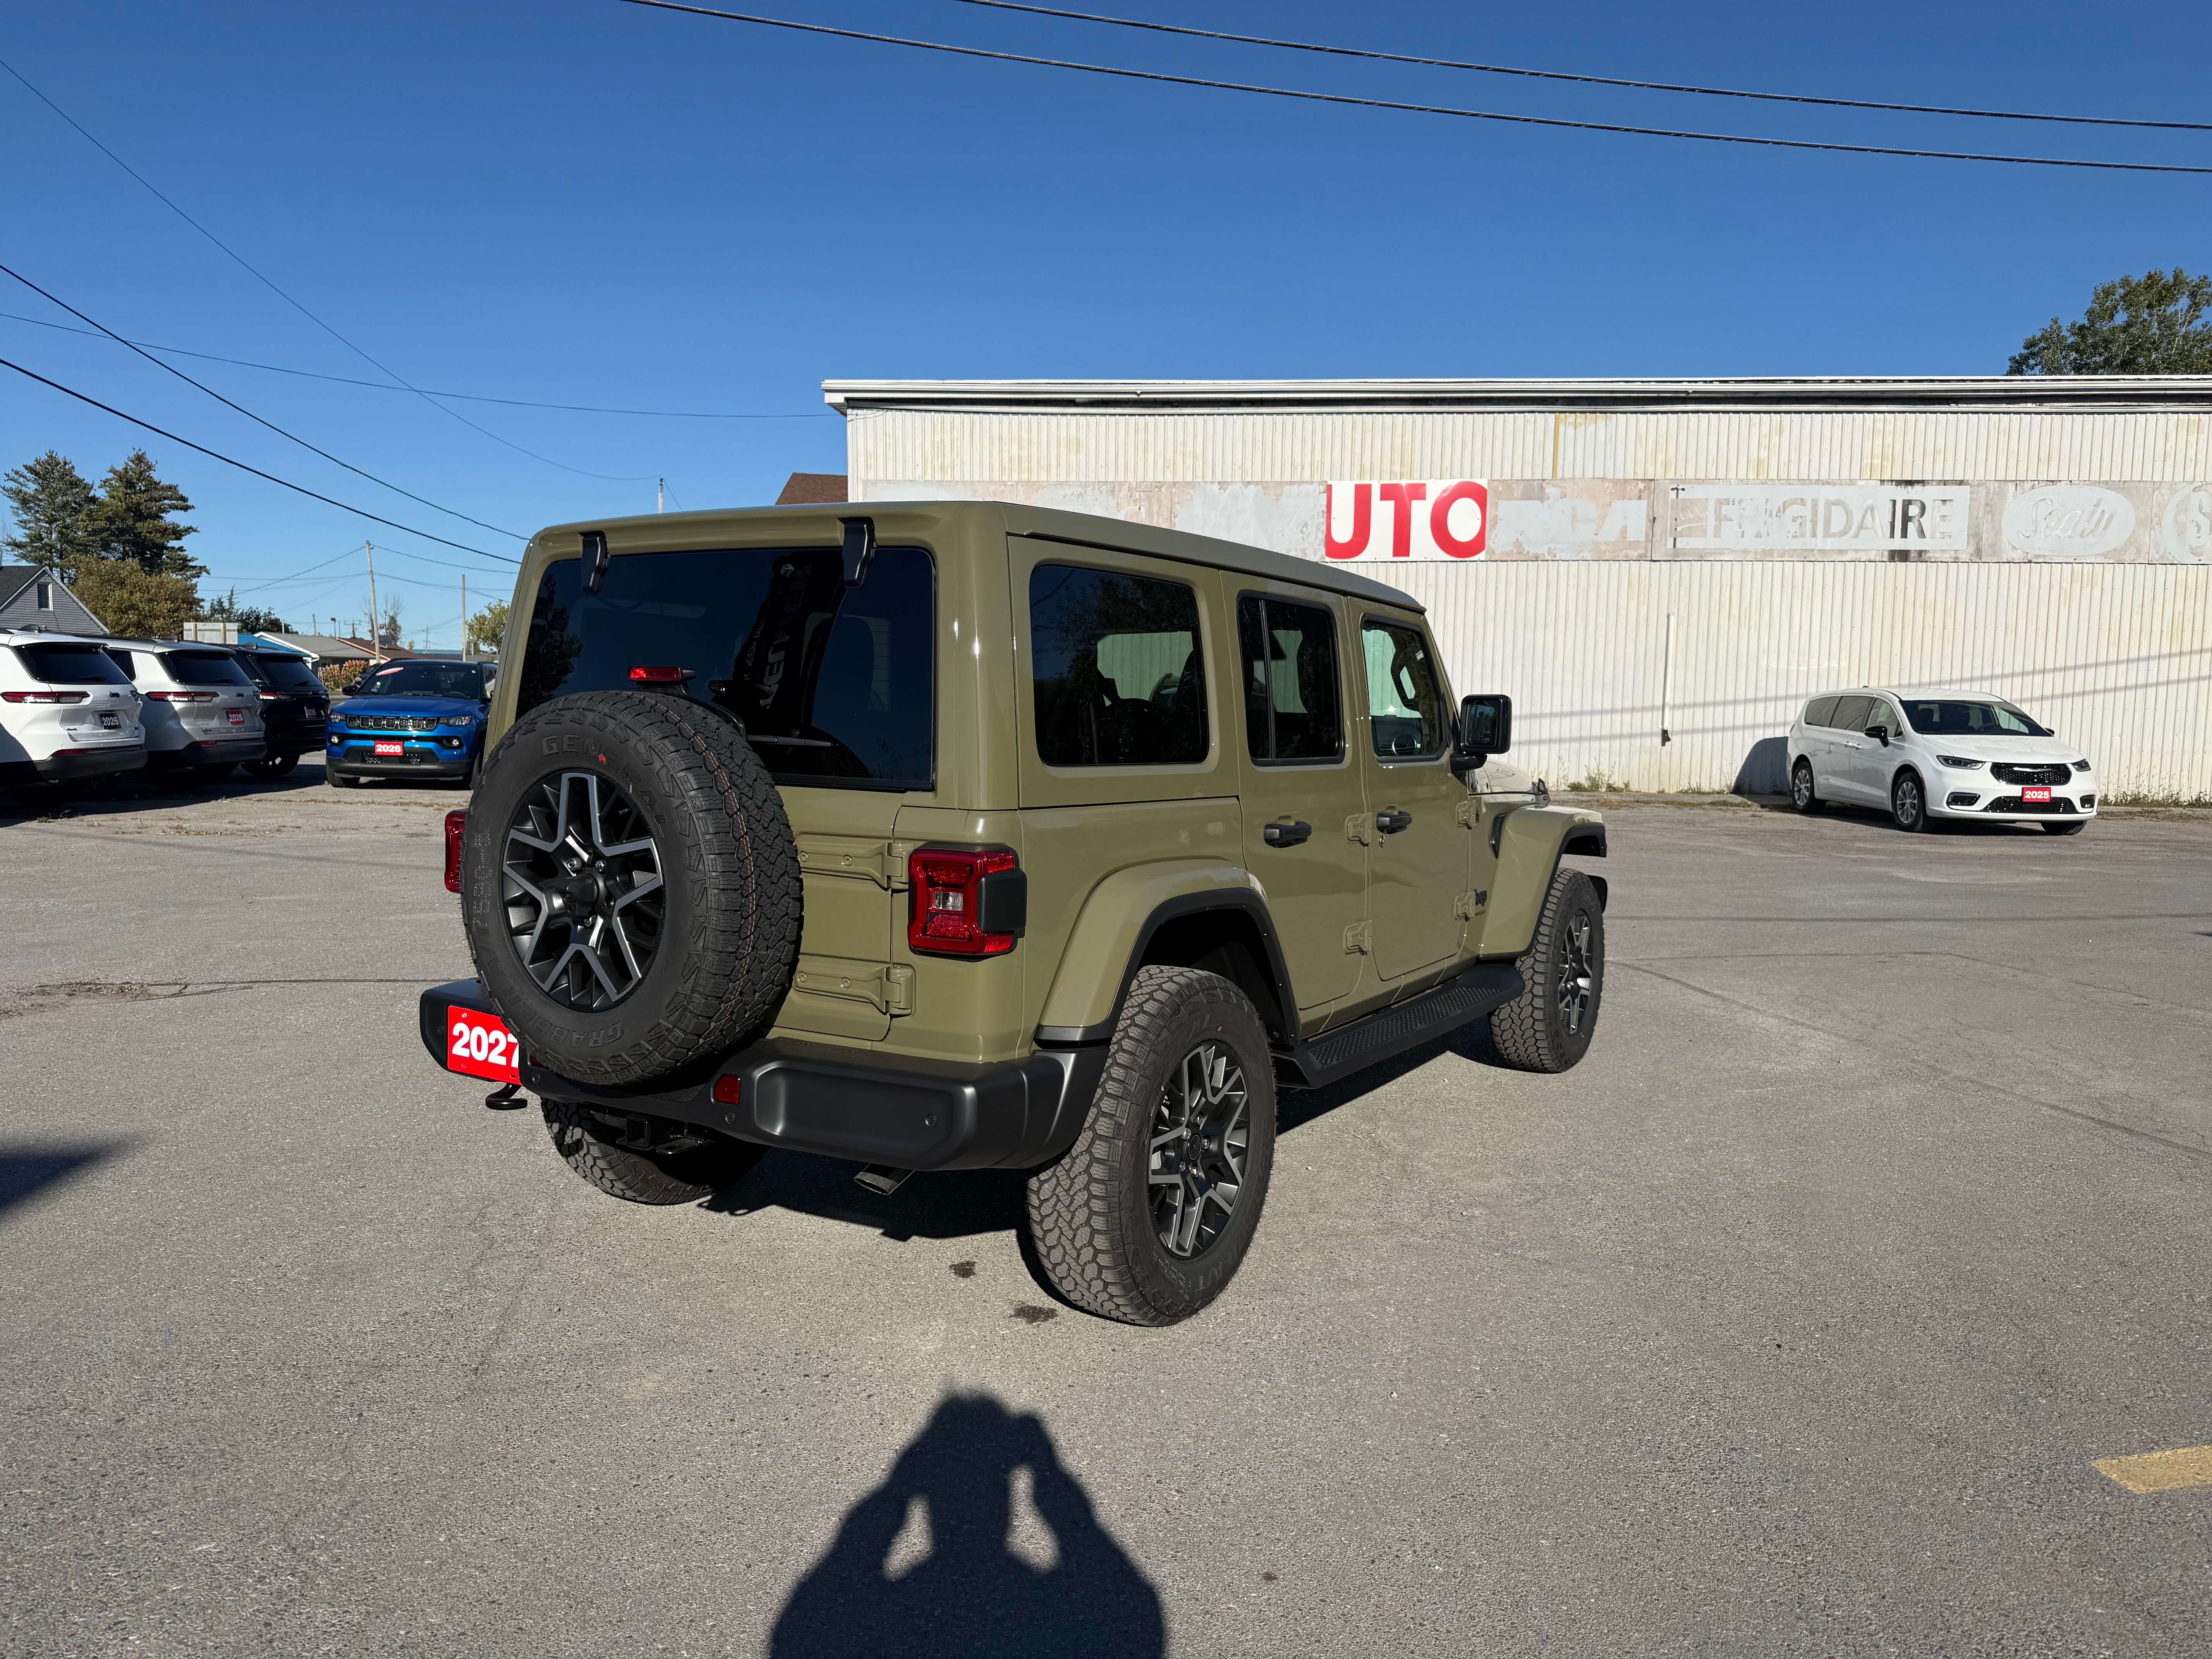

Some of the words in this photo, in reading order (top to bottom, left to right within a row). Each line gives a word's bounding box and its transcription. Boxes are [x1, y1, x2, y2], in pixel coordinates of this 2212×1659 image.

[1325, 481, 1487, 559] UTO
[102, 717, 119, 726] 2026
[229, 714, 243, 722] 2026
[376, 744, 401, 754] 2026
[2025, 790, 2050, 799] 2025
[452, 1022, 519, 1068] 2027
